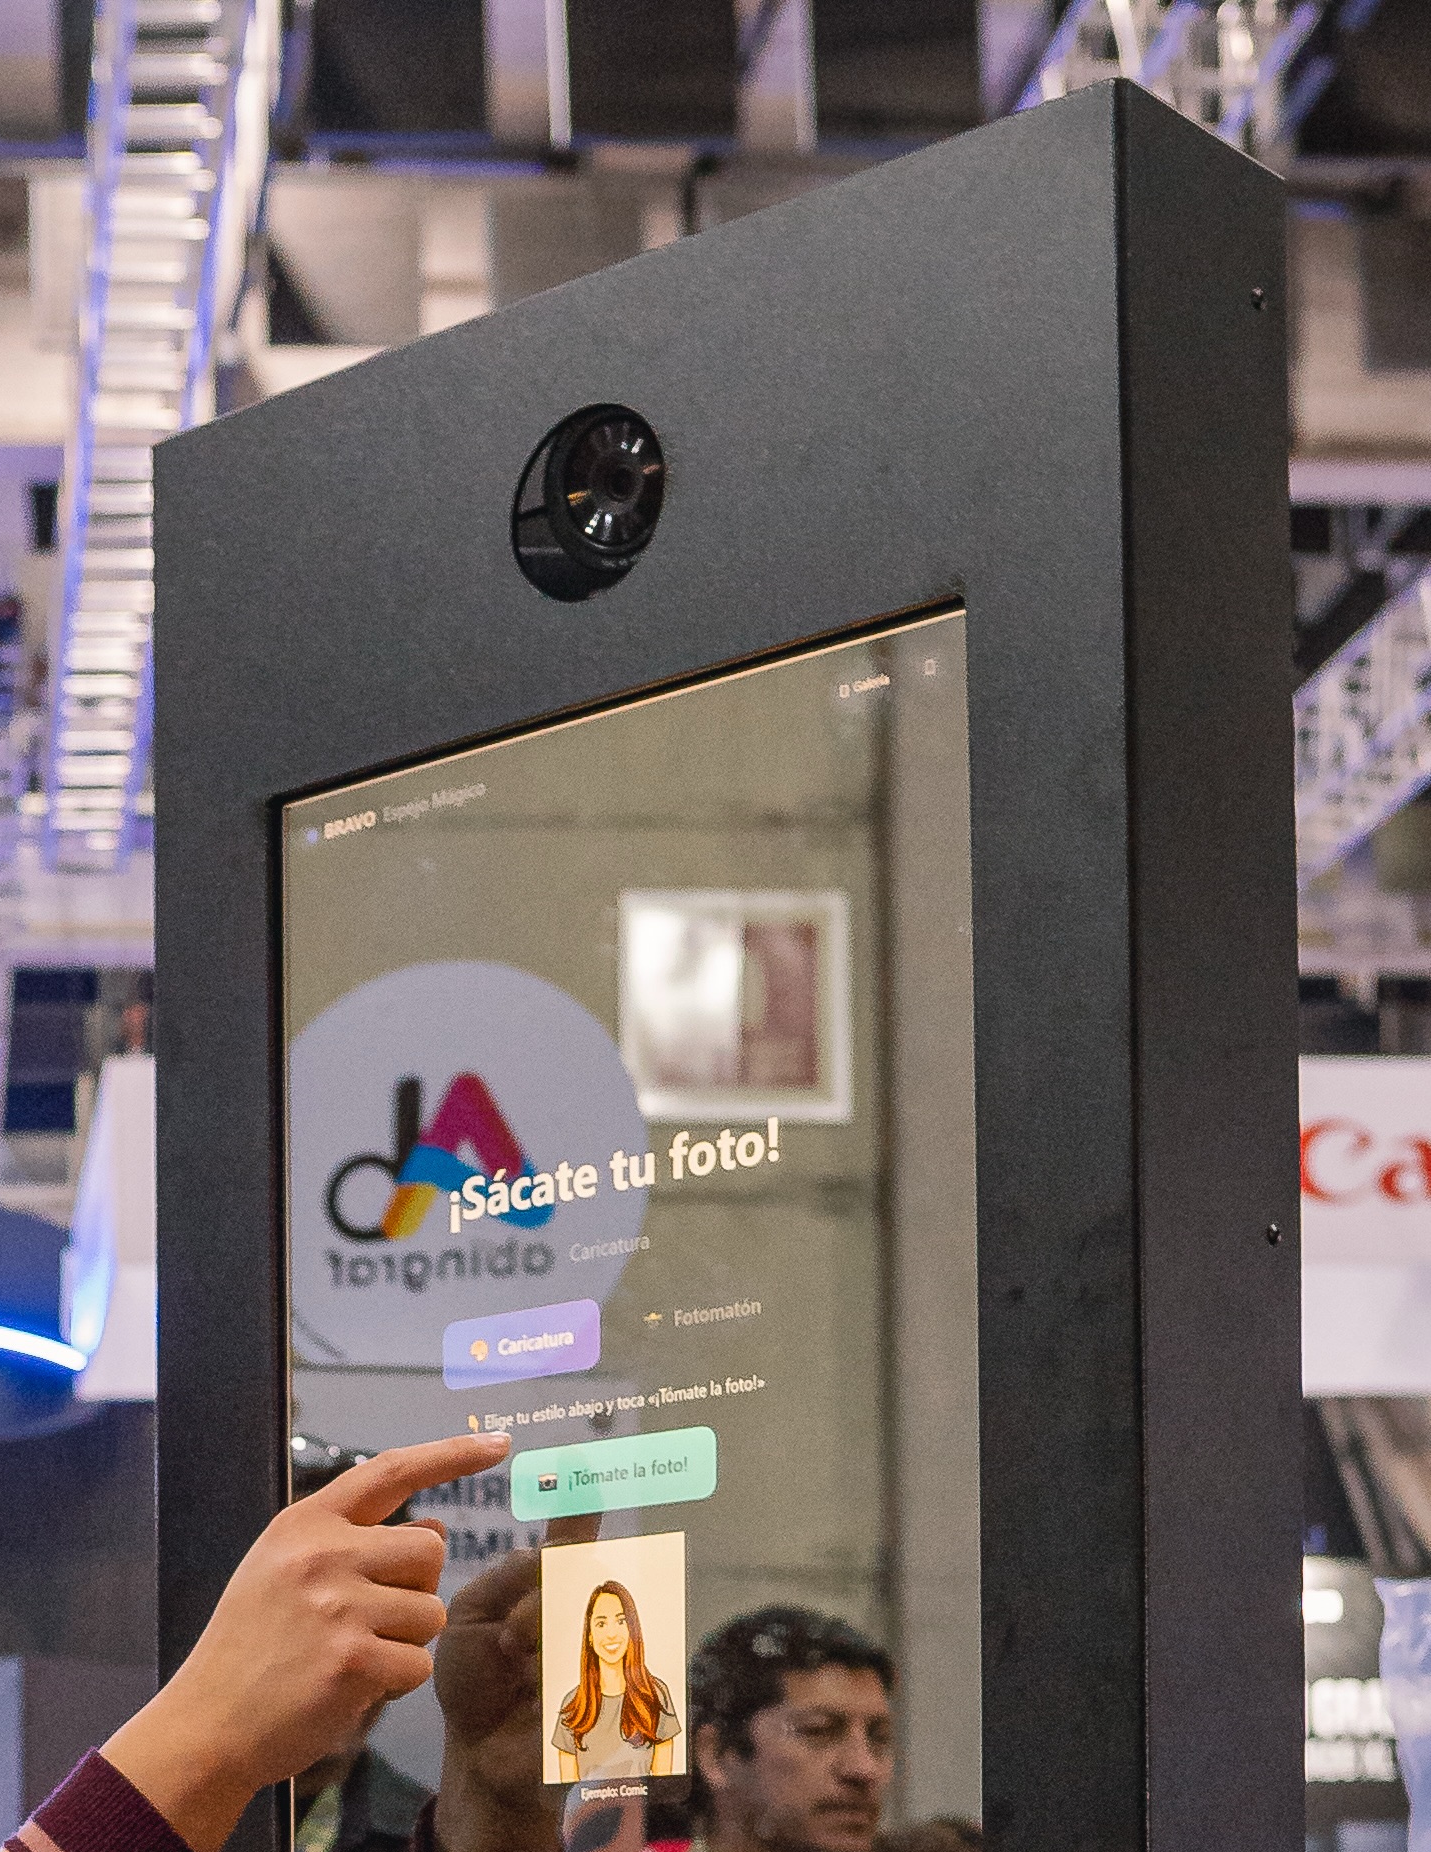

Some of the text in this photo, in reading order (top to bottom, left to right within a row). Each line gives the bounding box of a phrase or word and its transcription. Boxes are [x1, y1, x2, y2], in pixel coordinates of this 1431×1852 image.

[323, 811, 376, 840] BRAVO
[383, 800, 430, 824] Espejo
[449, 1116, 781, 1234] ¡Sácate tu foto!
[568, 1233, 651, 1264] Caricatura
[673, 1299, 762, 1327] Fotomatón
[497, 1330, 574, 1357] Caricatura
[484, 1412, 514, 1431] Elige
[517, 1410, 530, 1424] tu
[532, 1404, 566, 1424] estilo
[568, 1397, 605, 1420] abajo
[604, 1400, 615, 1416] y
[616, 1394, 645, 1412] toca
[710, 1381, 723, 1398] la
[568, 1456, 688, 1491] ¡Tómate la foto!
[619, 1783, 649, 1799] Comic
